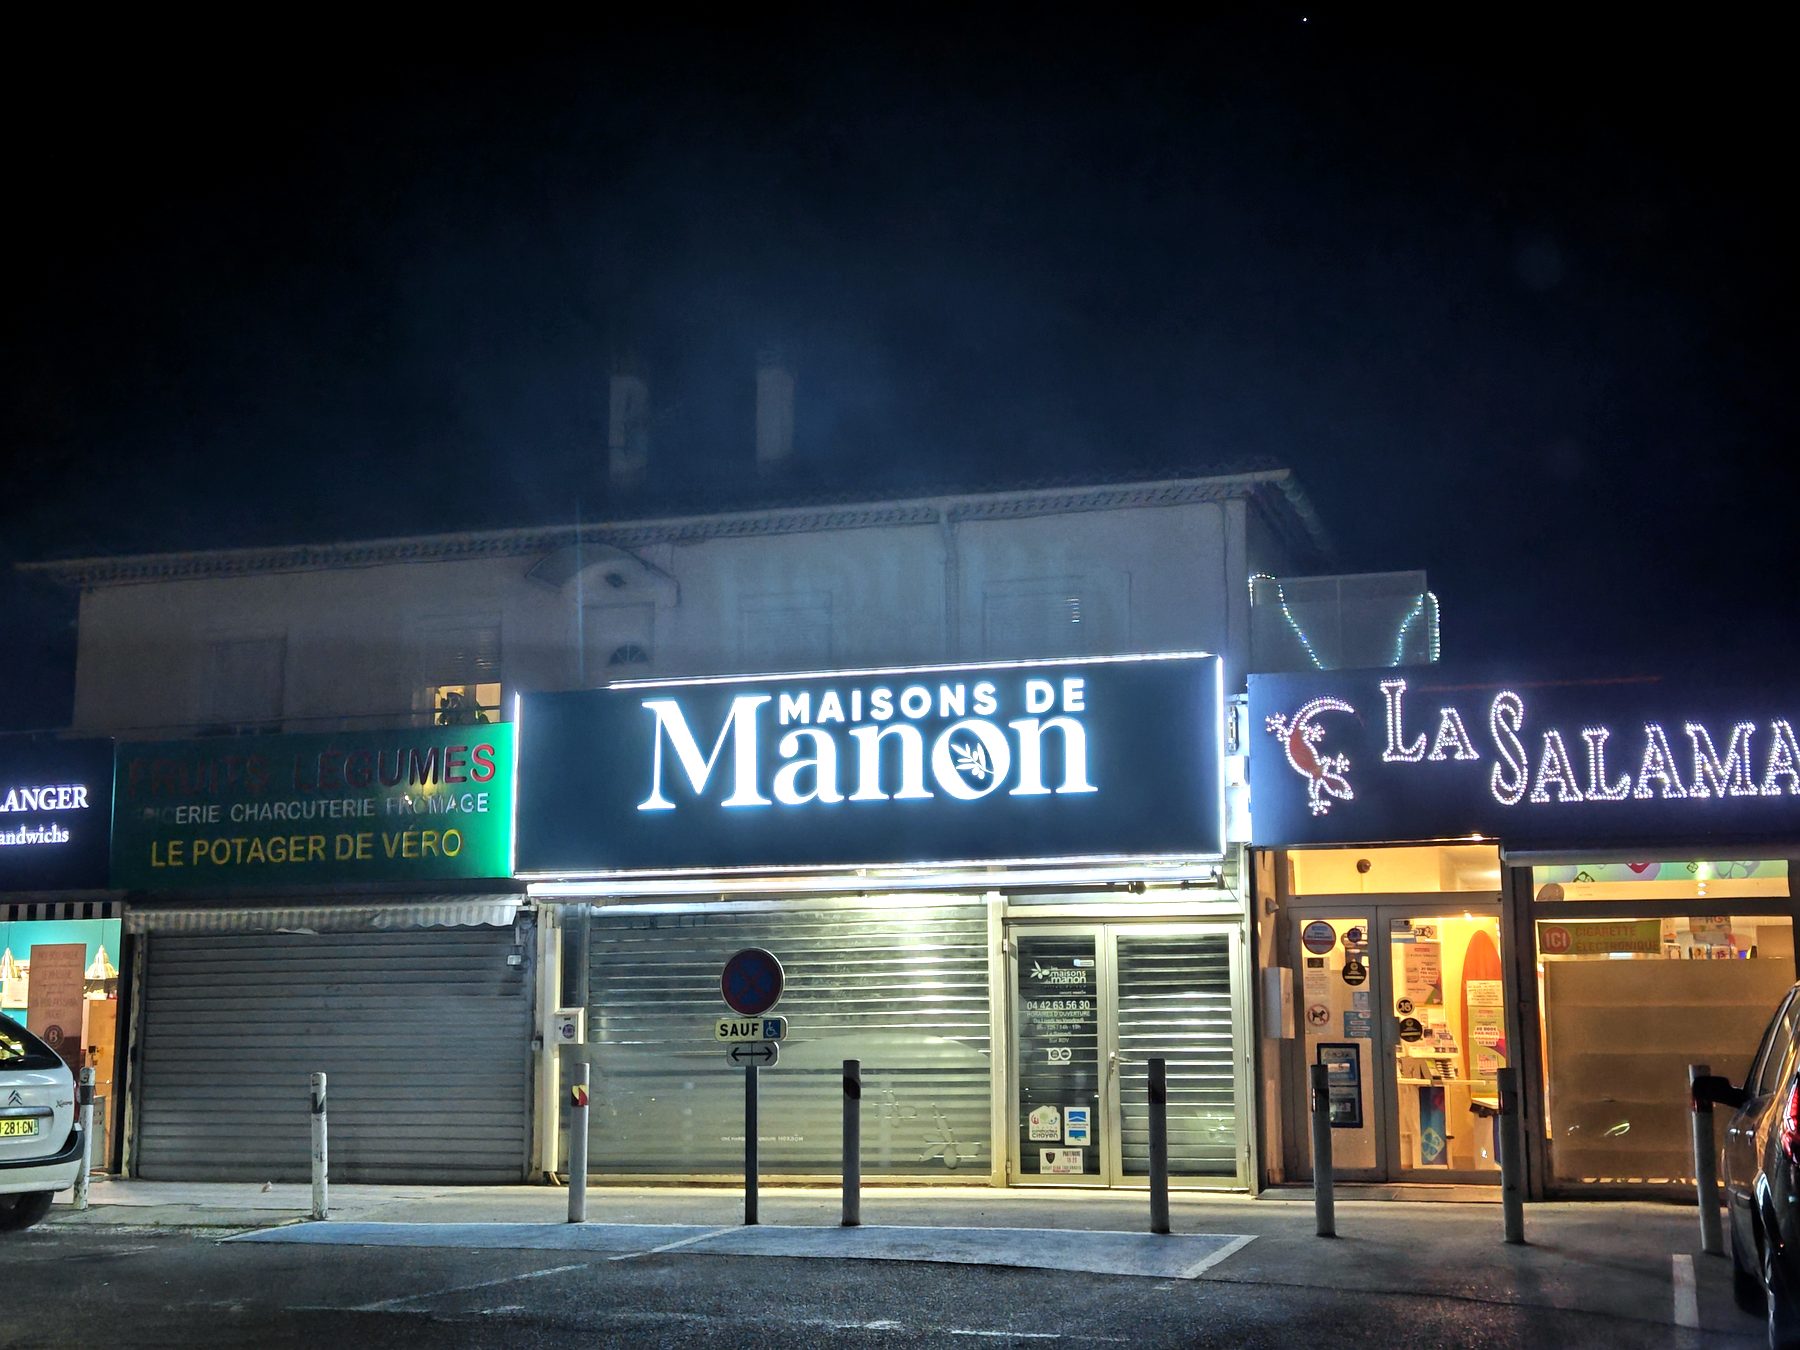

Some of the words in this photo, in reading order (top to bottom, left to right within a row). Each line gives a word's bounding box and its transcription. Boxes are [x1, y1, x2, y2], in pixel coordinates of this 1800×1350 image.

[778, 682, 998, 725] MAISONS
[1025, 678, 1086, 713] DE
[637, 694, 1098, 810] Manon
[128, 755, 270, 799] FRUITS
[230, 798, 376, 822] CHARCUTERIE
[386, 792, 490, 816] FROMAGE
[151, 840, 184, 867] LE
[192, 834, 327, 865] POTAGER
[335, 832, 374, 860] DE
[381, 825, 462, 858] VÉRO
[1545, 932, 1567, 948] ICI
[1575, 925, 1638, 937] CIGARETTE
[1051, 976, 1086, 984] manon
[1027, 1001, 1038, 1010] 04
[1040, 1001, 1051, 1010] 42
[1053, 1001, 1064, 1010] 63
[1066, 1001, 1077, 1010] 56
[1079, 1001, 1090, 1010] 30
[719, 1023, 760, 1037] SAUF
